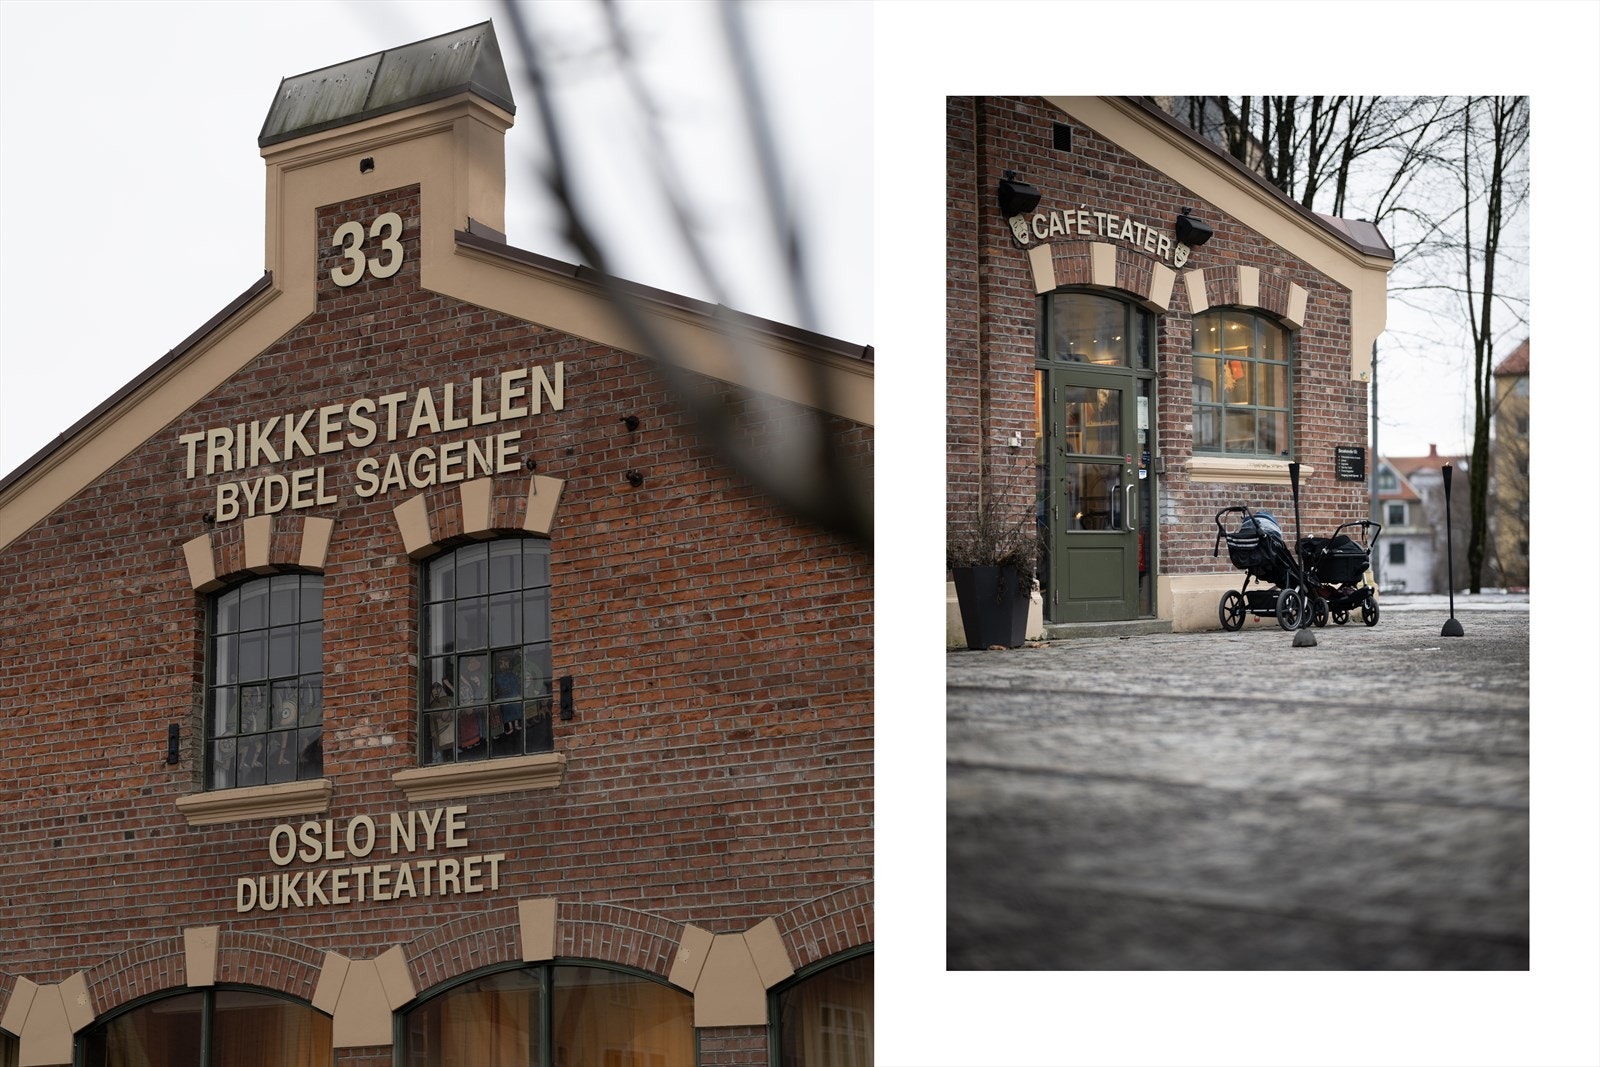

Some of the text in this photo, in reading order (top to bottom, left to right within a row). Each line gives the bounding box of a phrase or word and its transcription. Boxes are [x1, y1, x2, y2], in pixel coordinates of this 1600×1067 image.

[331, 212, 404, 287] 33
[1031, 204, 1172, 261] CAFÉTEATER
[179, 361, 565, 479] TRIKKESTALLEN
[216, 430, 522, 522] BYDEL SAGENE
[268, 805, 468, 866] OSLO NYE
[236, 853, 506, 913] DUKKETEATRET
